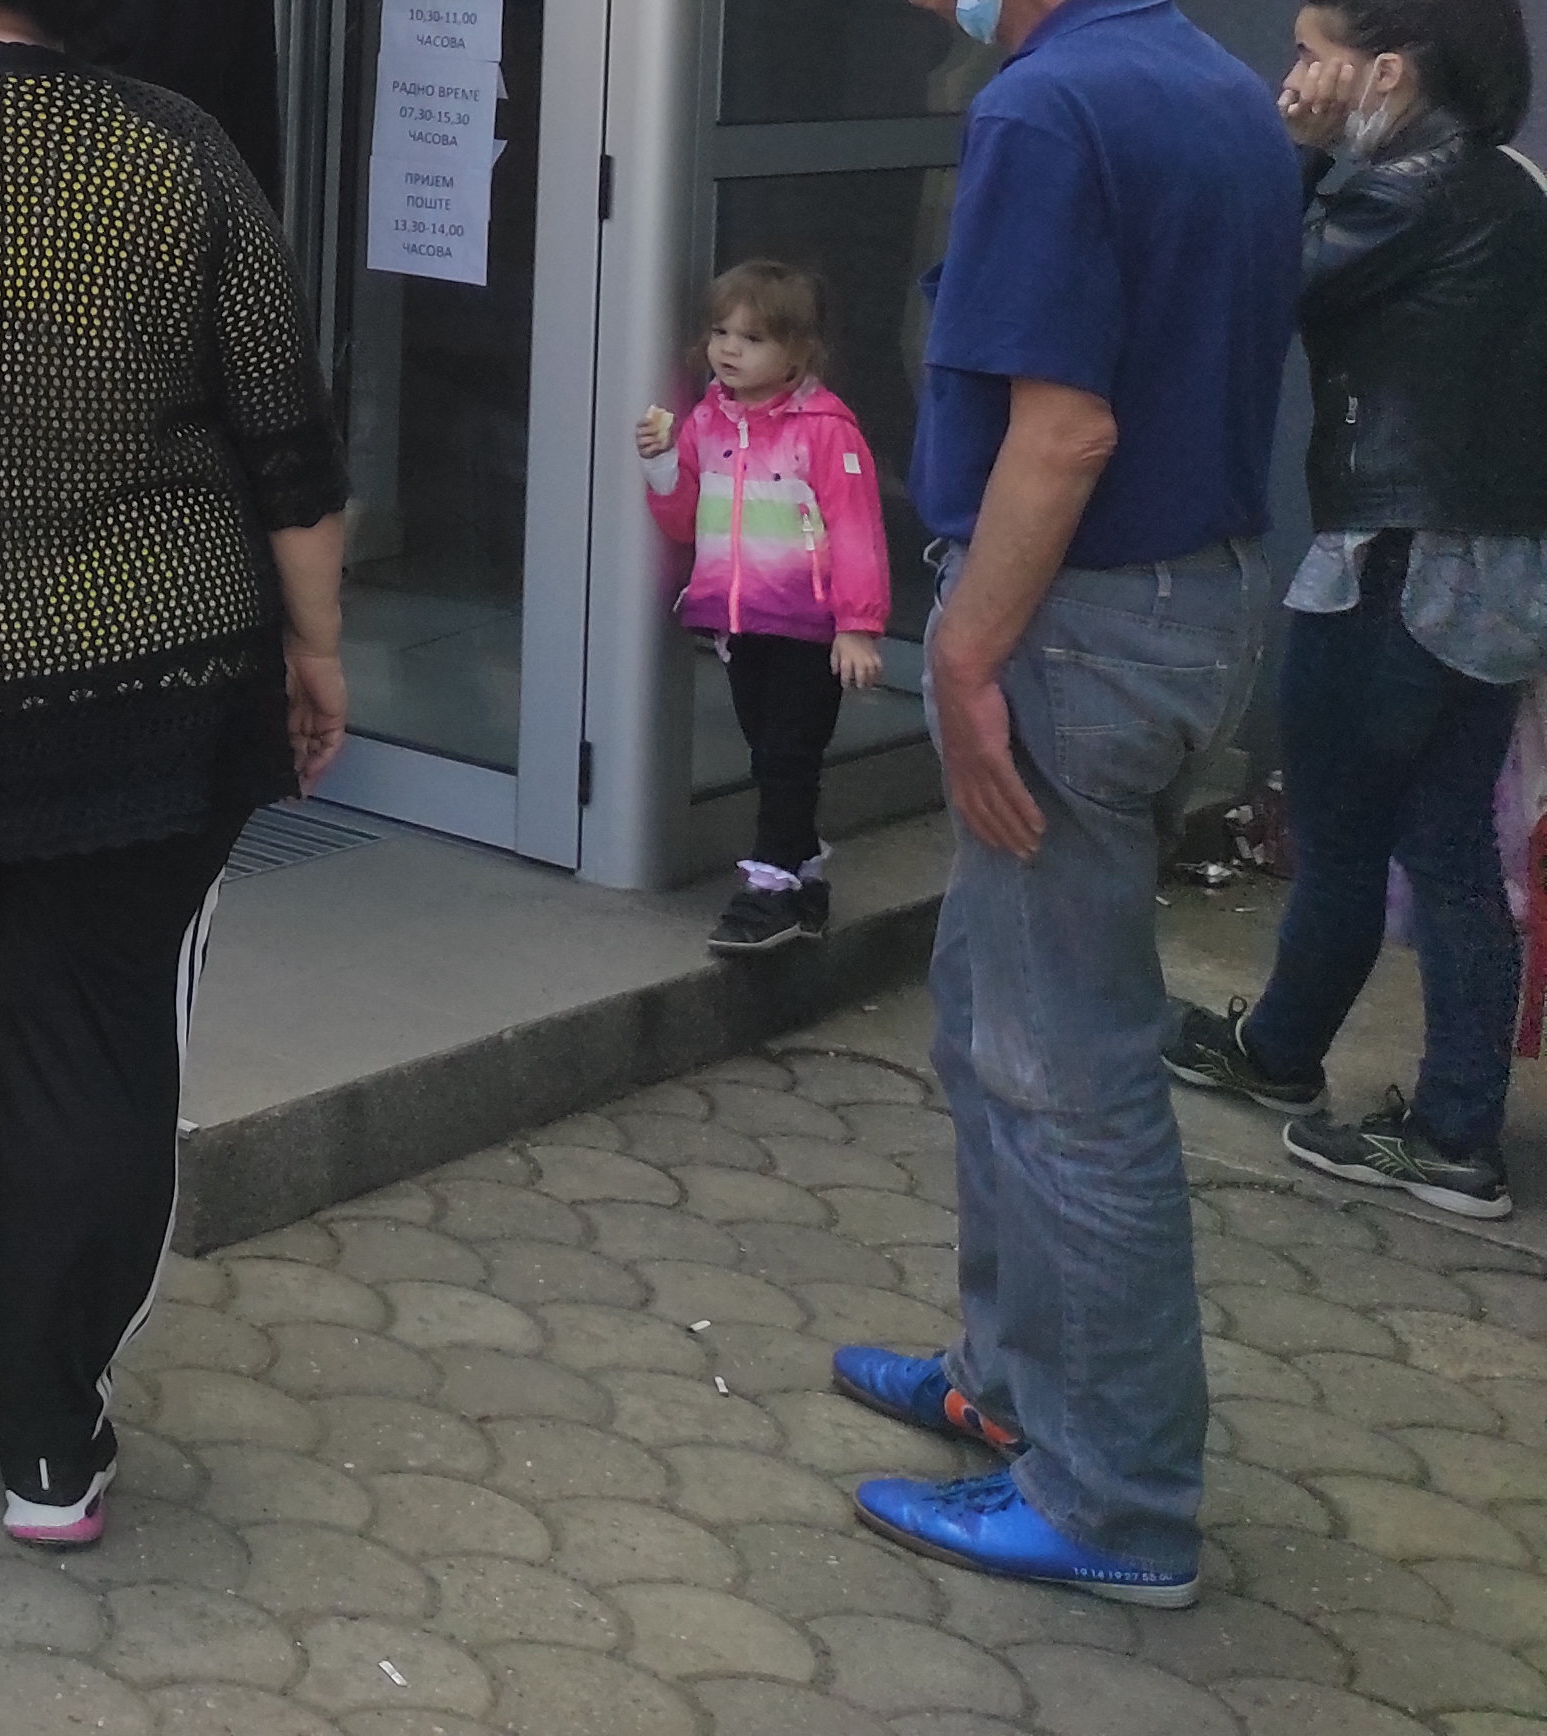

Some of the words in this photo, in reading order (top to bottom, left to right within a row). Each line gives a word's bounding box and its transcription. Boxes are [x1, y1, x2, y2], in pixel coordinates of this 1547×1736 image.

[416, 34, 466, 49] ЧАСОВА
[392, 80, 435, 97] РАДНО
[438, 86, 480, 102] ВРЕМЕ
[408, 130, 458, 146] ЧАСОВА
[404, 172, 454, 188] ПРИЈЕМ
[407, 195, 451, 211] ПОШТЕ
[402, 243, 453, 258] ЧАСОВА
